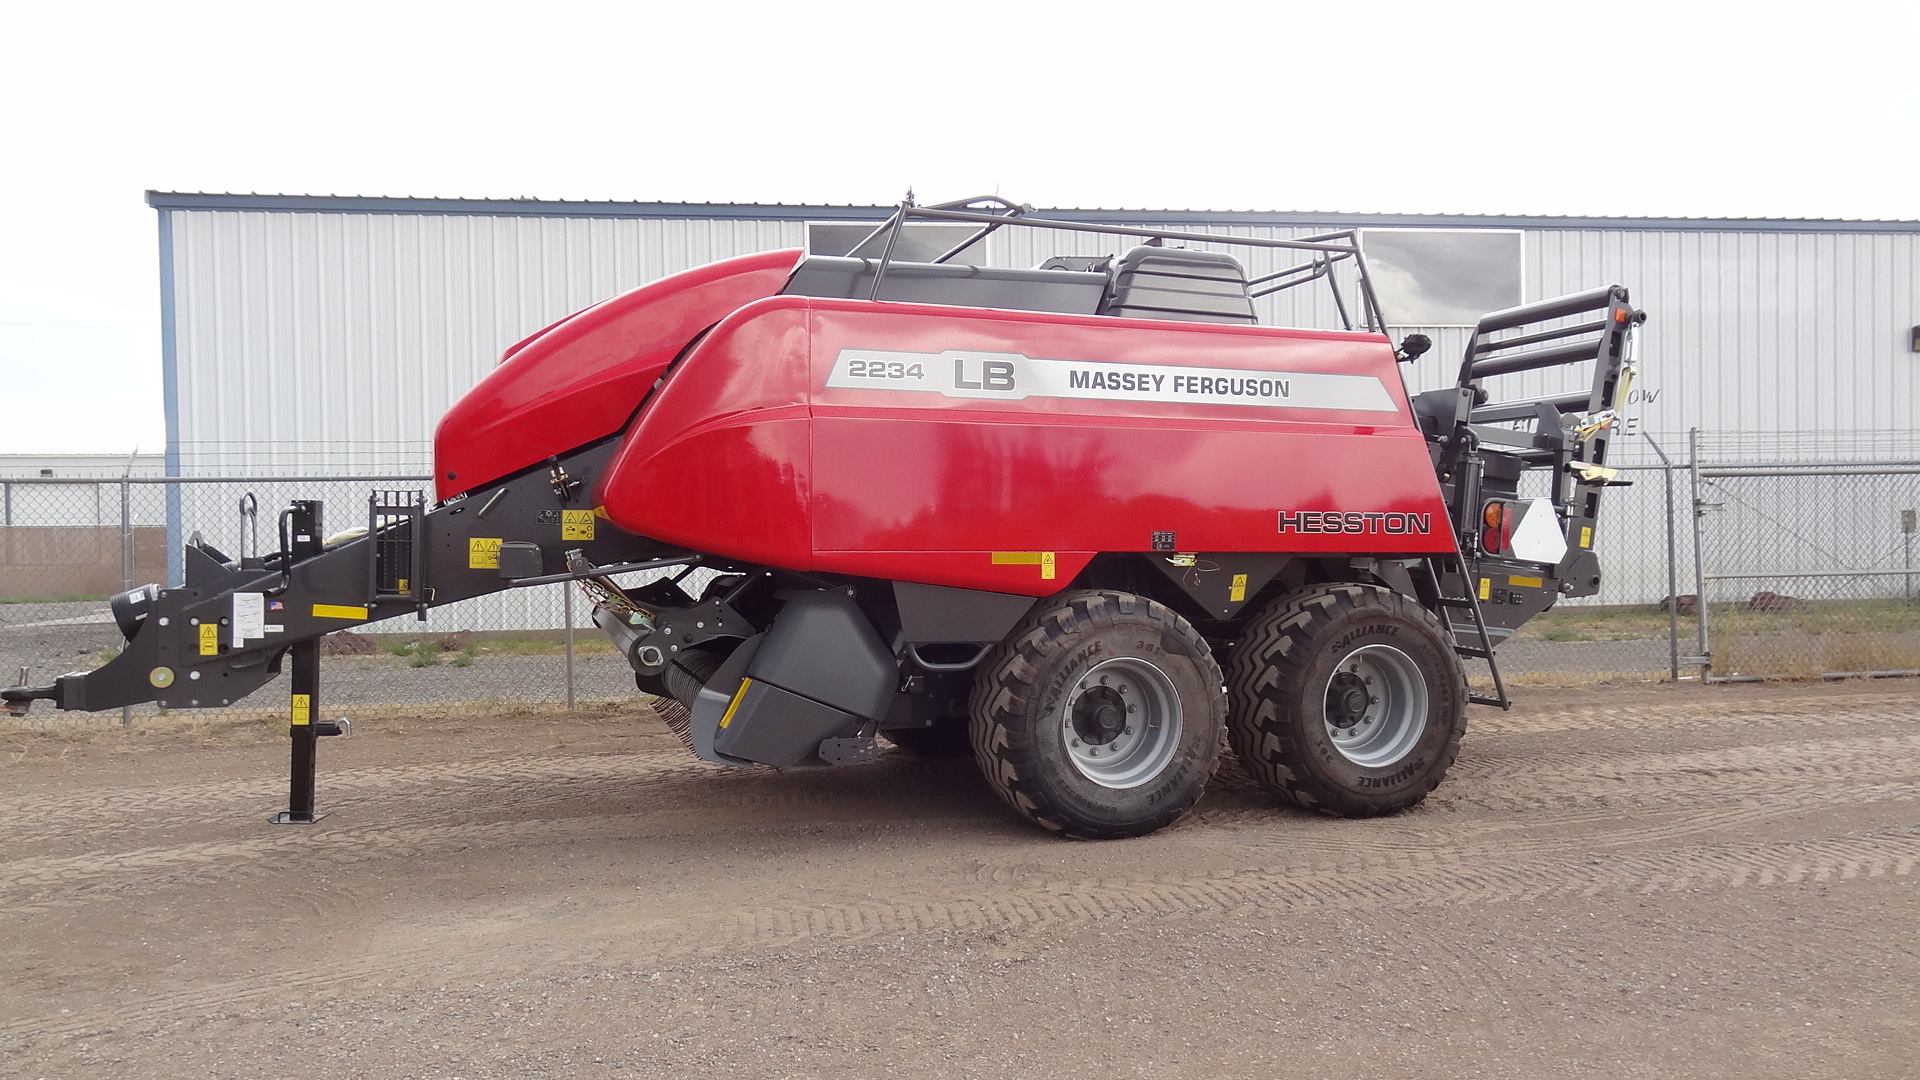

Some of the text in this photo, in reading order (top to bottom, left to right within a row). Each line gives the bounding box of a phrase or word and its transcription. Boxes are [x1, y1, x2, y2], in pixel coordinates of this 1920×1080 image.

[848, 358, 1291, 398] 2234 LB MASSEY FERGUSON
[1277, 510, 1431, 535] HESSTON
[1341, 624, 1401, 646] ALLIANCE
[1049, 640, 1103, 706] ALLIANCE
[1357, 766, 1416, 788] ALLIANCE
